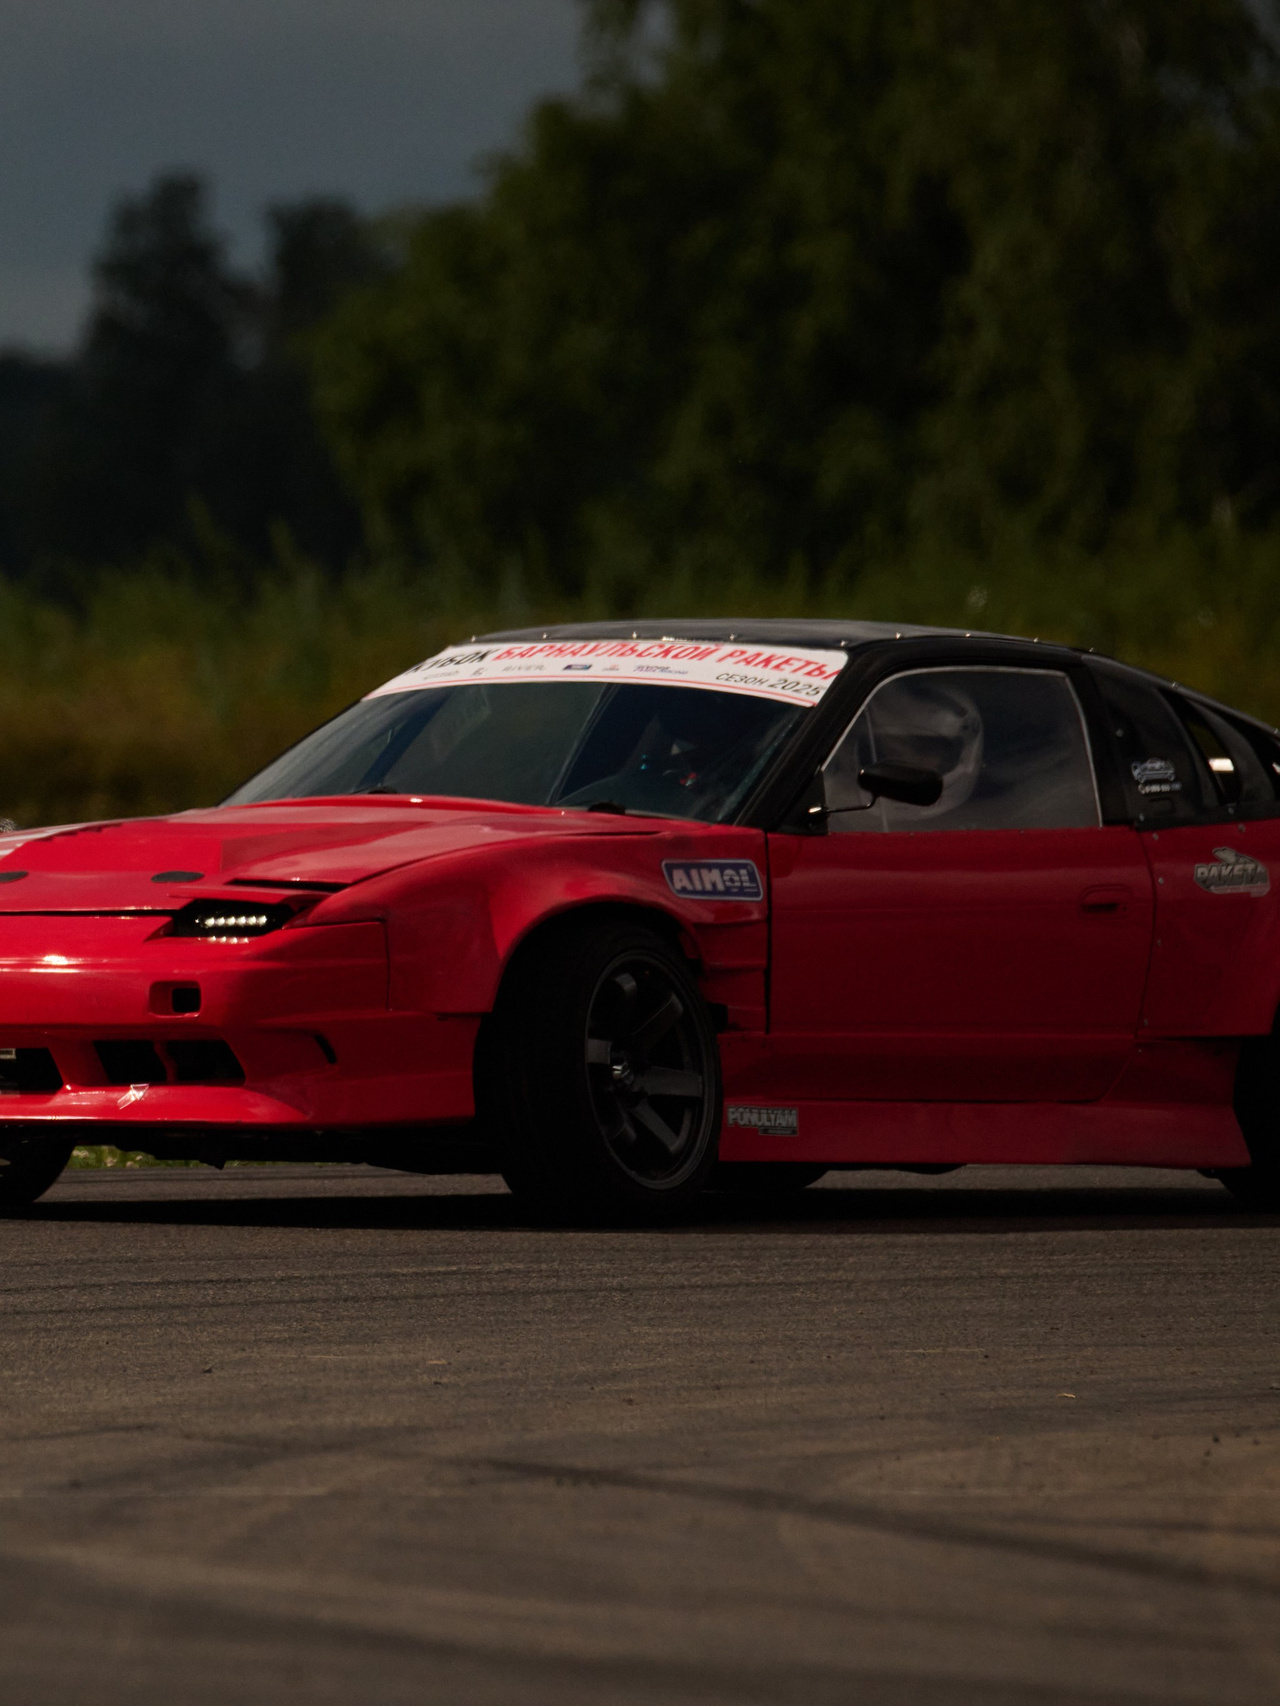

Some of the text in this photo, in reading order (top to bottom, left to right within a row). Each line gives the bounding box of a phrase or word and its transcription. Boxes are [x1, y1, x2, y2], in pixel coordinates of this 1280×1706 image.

[491, 643, 724, 662] БАРНАУЛЬСКОЙ
[716, 649, 843, 681] РАКЕТЫ
[716, 672, 821, 697] СЕЗОН 2025
[672, 868, 757, 892] AIMOL
